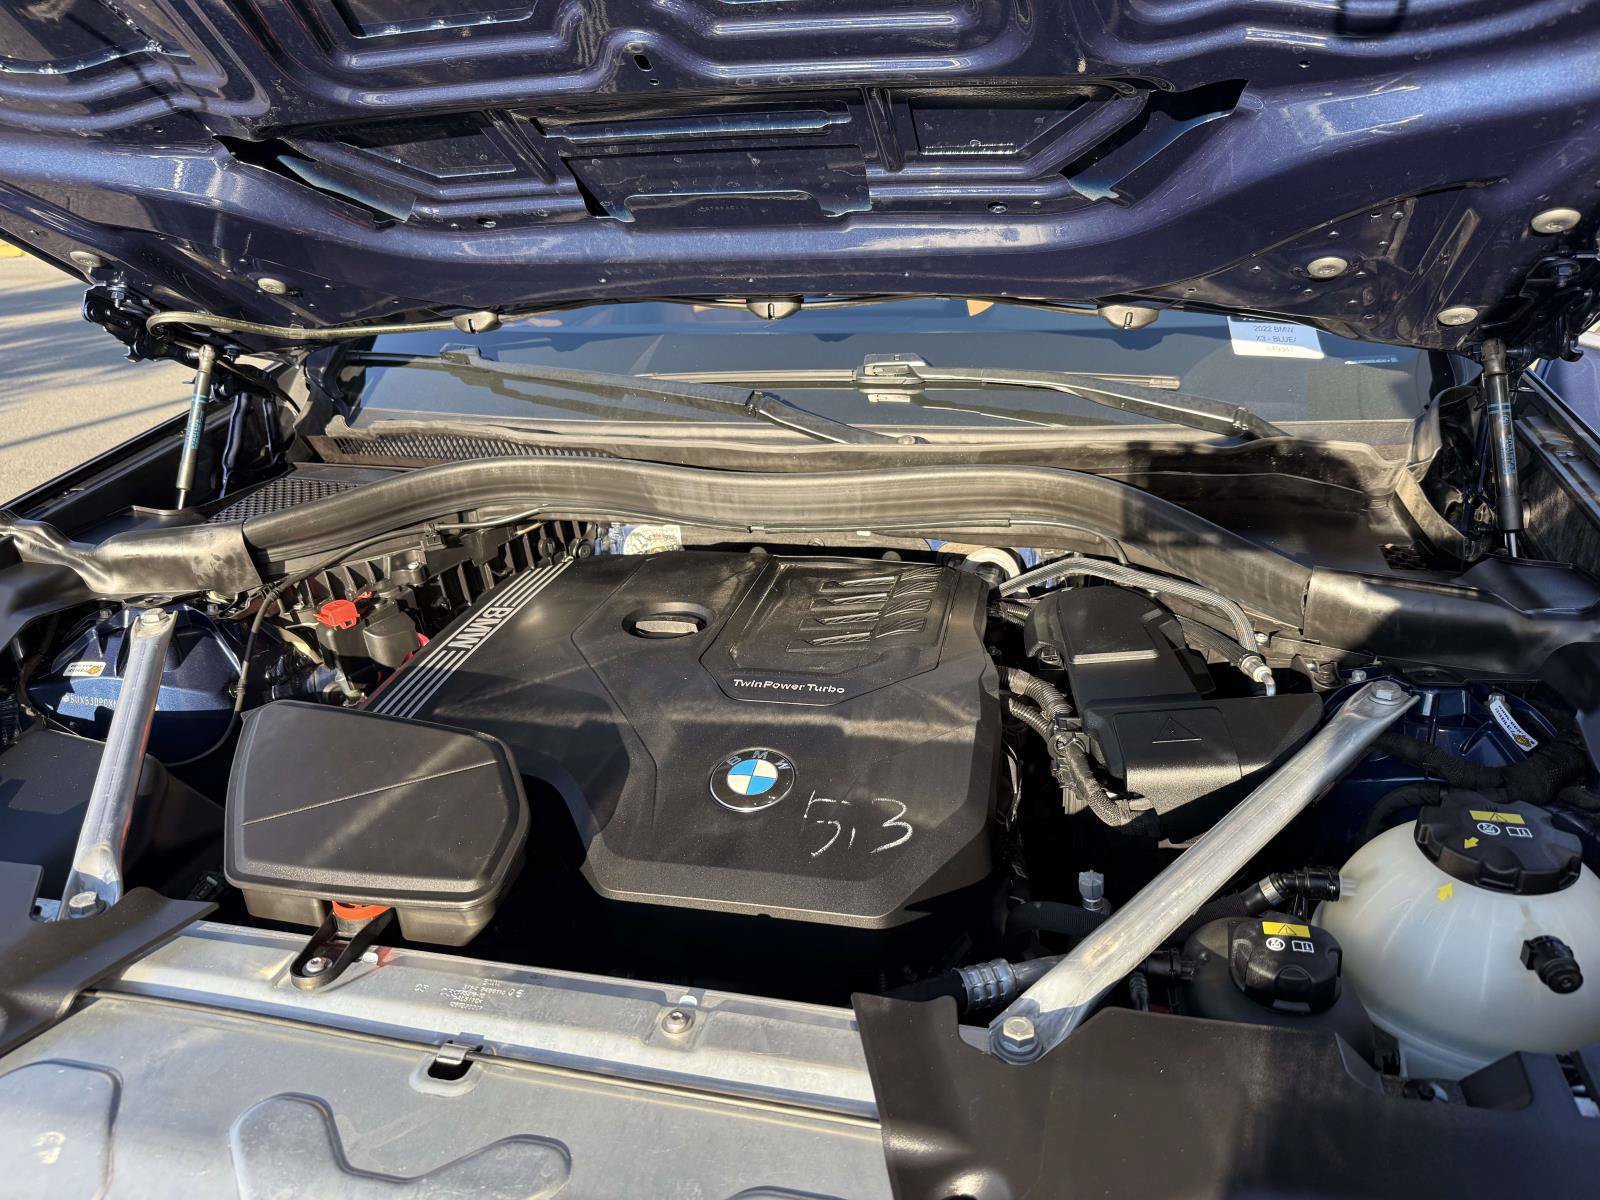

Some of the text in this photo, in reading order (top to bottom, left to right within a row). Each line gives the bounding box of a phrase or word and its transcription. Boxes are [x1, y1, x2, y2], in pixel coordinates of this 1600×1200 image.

[447, 607, 515, 650] BMW
[807, 683, 845, 694] Turbo
[726, 750, 791, 770] BMW
